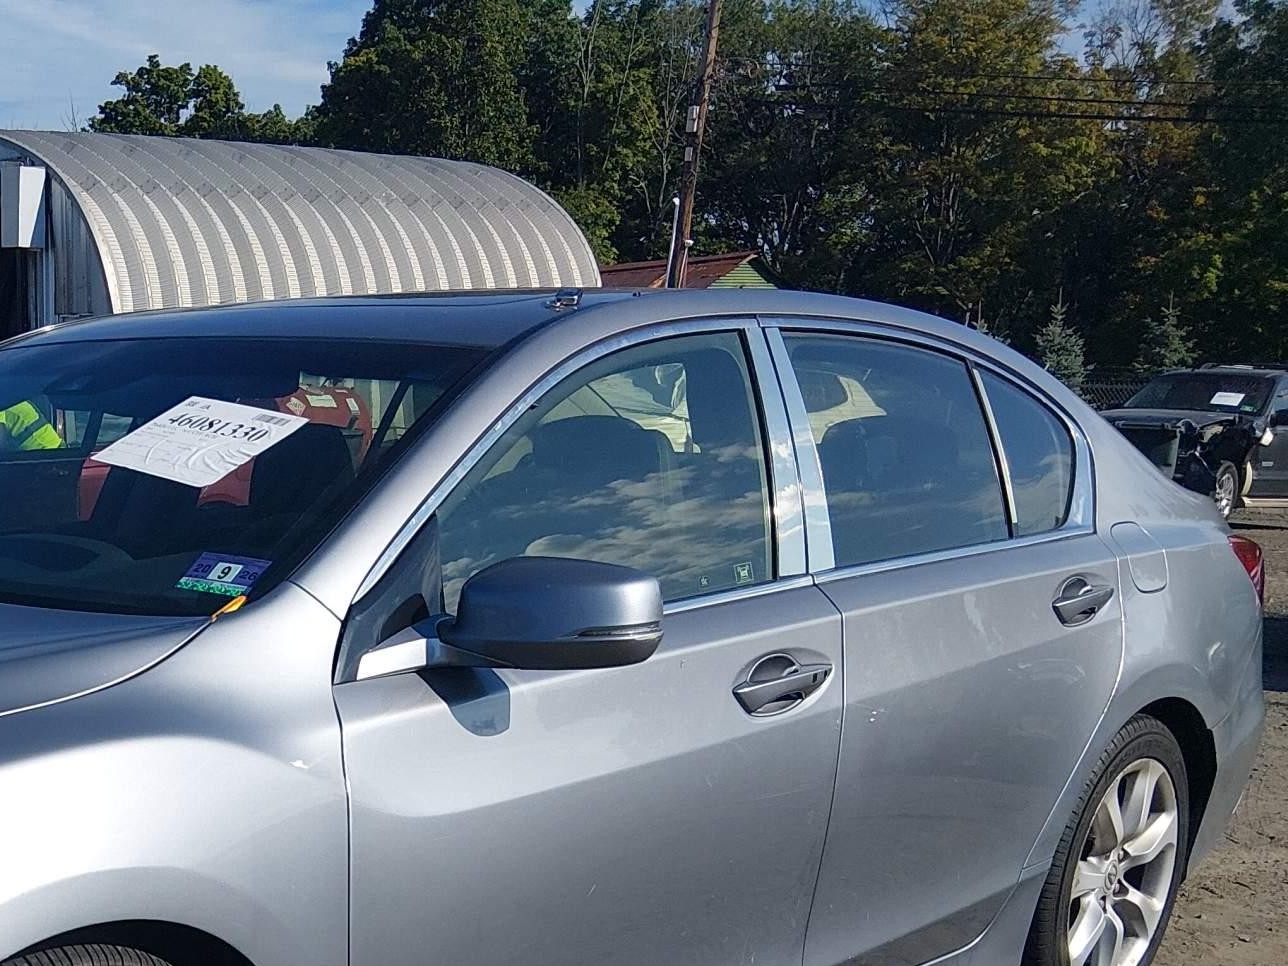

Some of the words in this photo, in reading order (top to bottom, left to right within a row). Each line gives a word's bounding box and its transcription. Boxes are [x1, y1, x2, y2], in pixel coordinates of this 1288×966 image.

[168, 412, 269, 442] 46081330
[192, 563, 211, 573] 20
[217, 566, 232, 580] 9
[239, 570, 258, 581] 26
